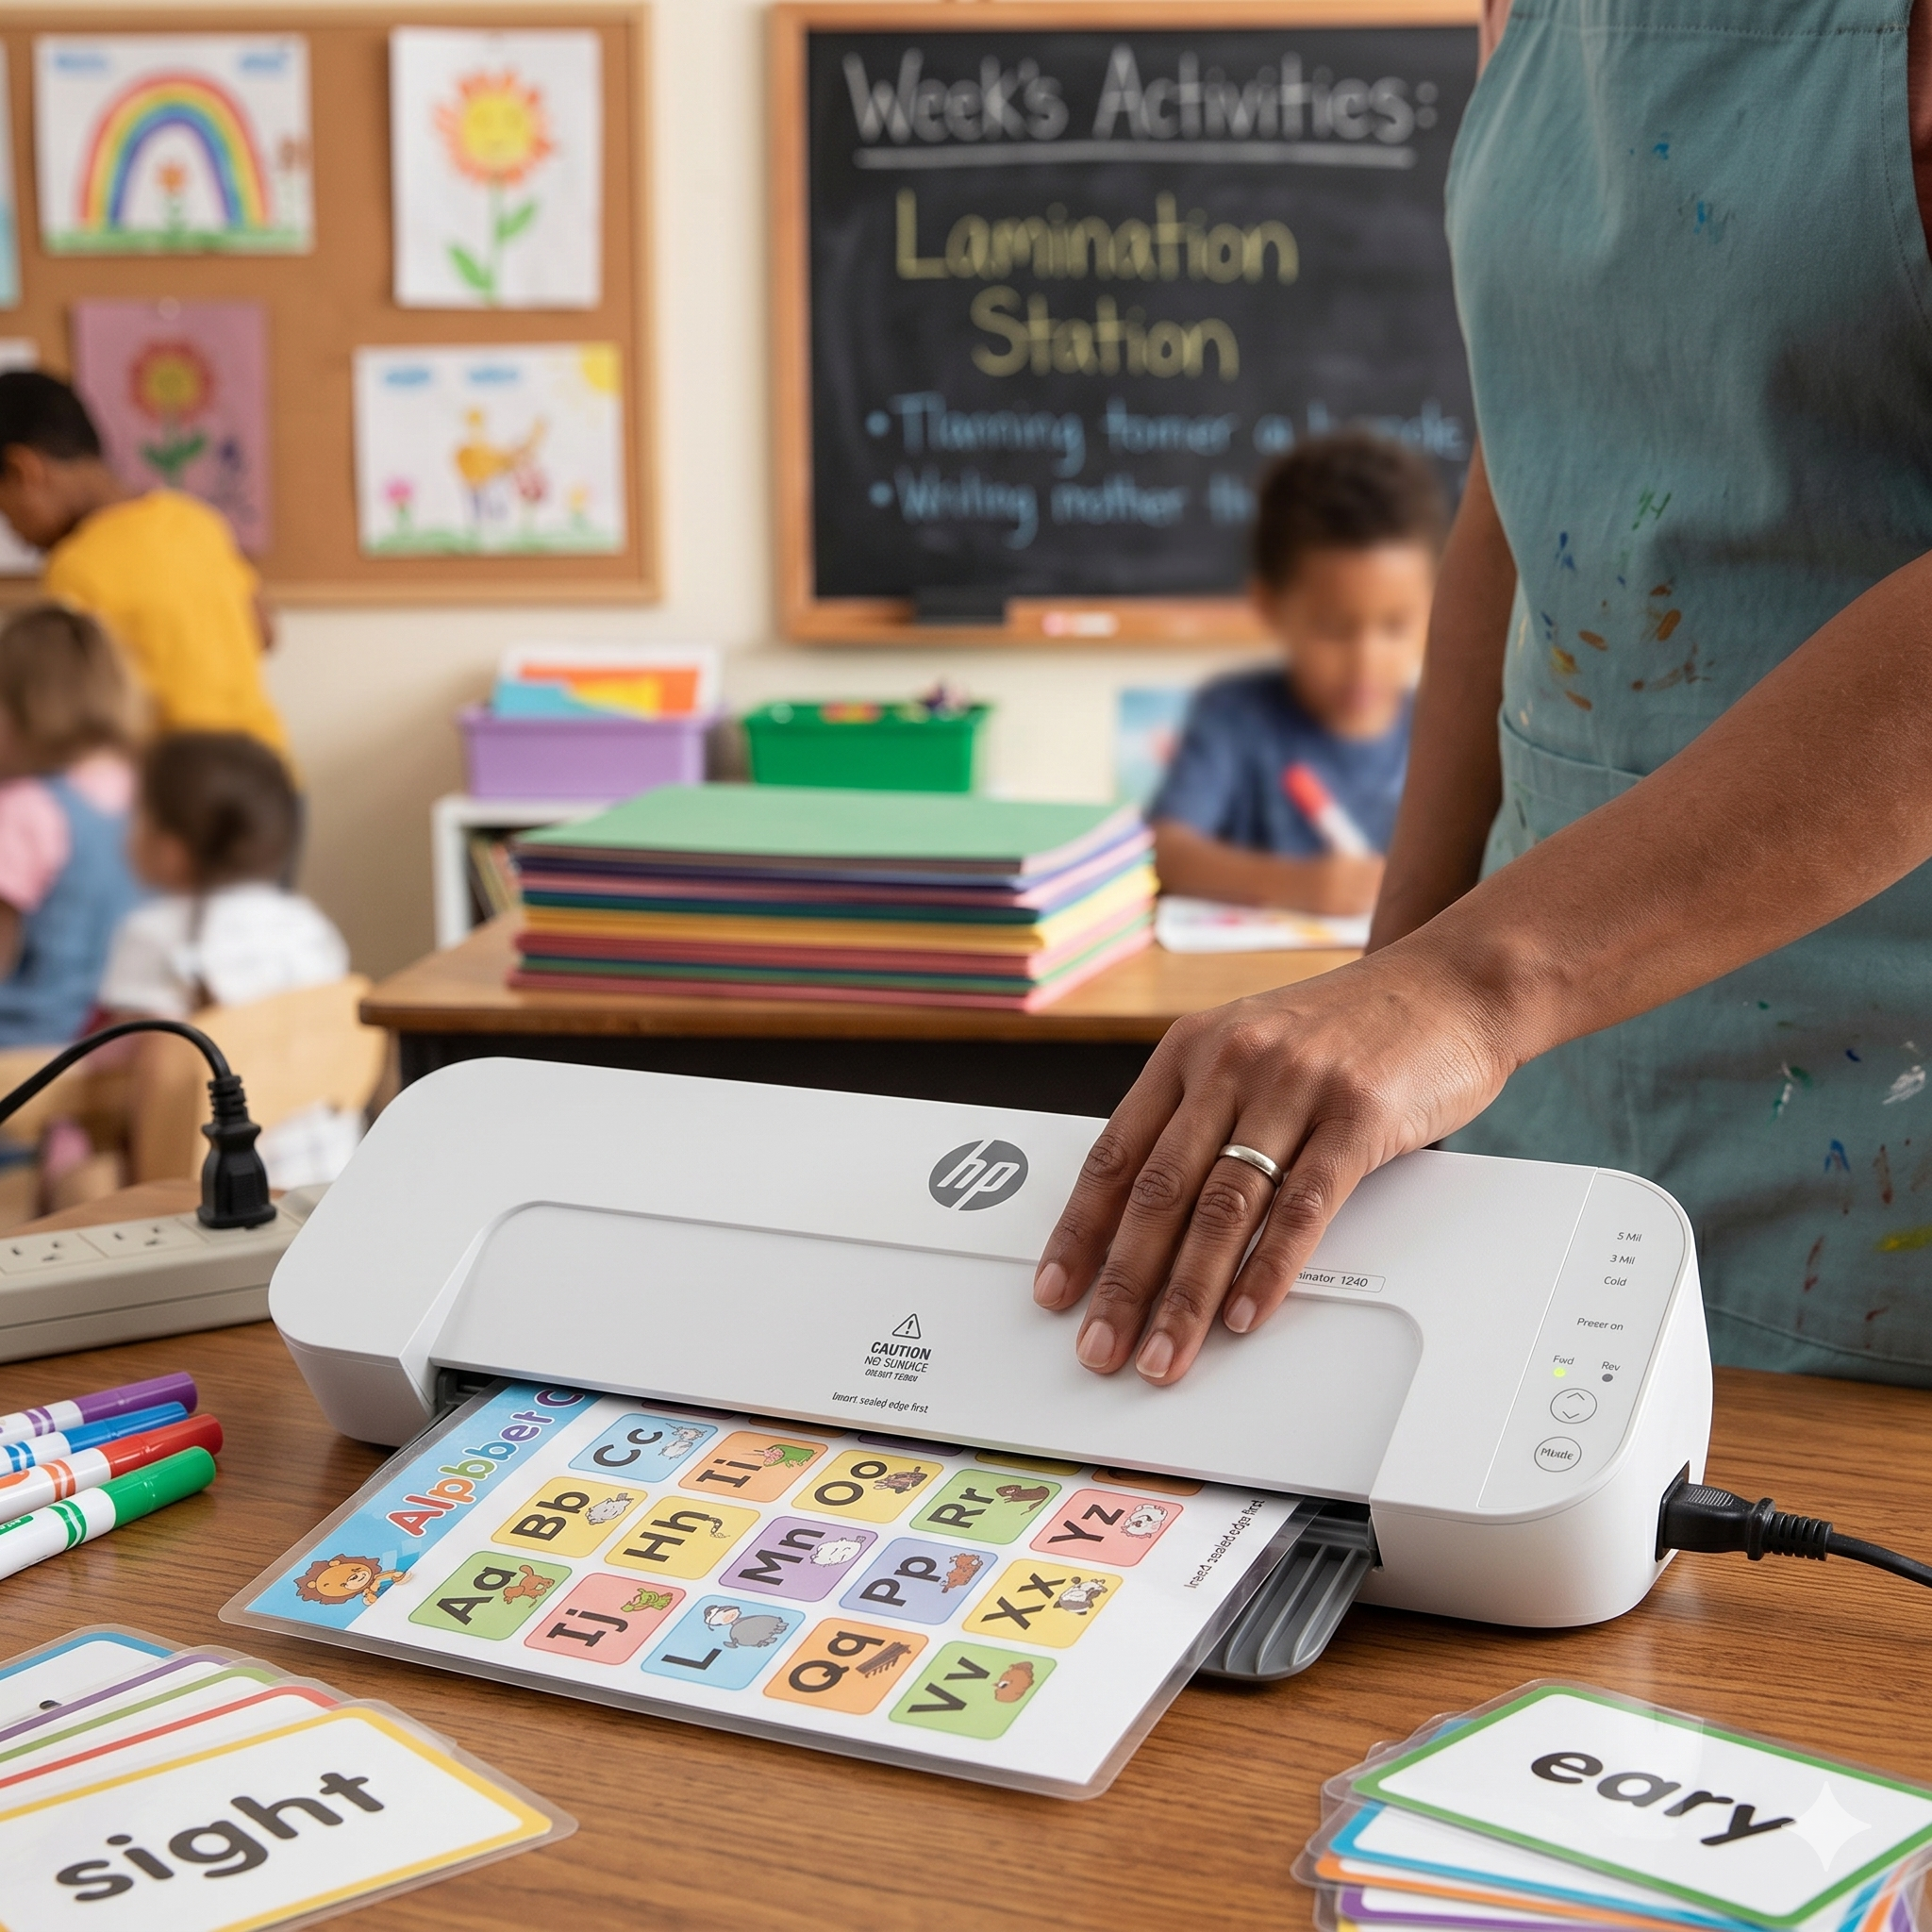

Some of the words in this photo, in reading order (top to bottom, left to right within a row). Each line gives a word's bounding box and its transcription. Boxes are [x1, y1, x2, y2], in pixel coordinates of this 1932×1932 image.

[842, 47, 1070, 143] Week's
[895, 190, 1300, 284] Lamination
[970, 285, 1241, 380] Station
[929, 1139, 1028, 1211] hp
[1609, 1255, 1618, 1263] 3
[1619, 1256, 1636, 1265] Mil
[1617, 1232, 1624, 1241] 5
[1625, 1233, 1642, 1242] Mil
[1341, 1275, 1369, 1288] 1240
[1604, 1275, 1627, 1286] Cold
[871, 1341, 932, 1360] CAUTION
[1609, 1323, 1624, 1331] on
[1601, 1361, 1621, 1372] Rev
[888, 1400, 909, 1412] edge
[910, 1402, 929, 1413] first
[592, 1428, 664, 1467] Cc
[695, 1458, 763, 1489] Ii
[814, 1460, 888, 1507] Oo
[509, 1491, 591, 1542] Bb
[926, 1487, 996, 1530] Rr
[1047, 1504, 1125, 1544] Yz
[738, 1528, 826, 1587] Mn
[858, 1555, 941, 1607] Pp
[436, 1566, 518, 1626] Aa
[981, 1573, 1067, 1630] Xx
[660, 1648, 723, 1671] L
[789, 1631, 886, 1693] Qq
[908, 1657, 991, 1714] Vv
[1531, 1752, 1797, 1846] eary
[56, 1773, 385, 1902] sight
